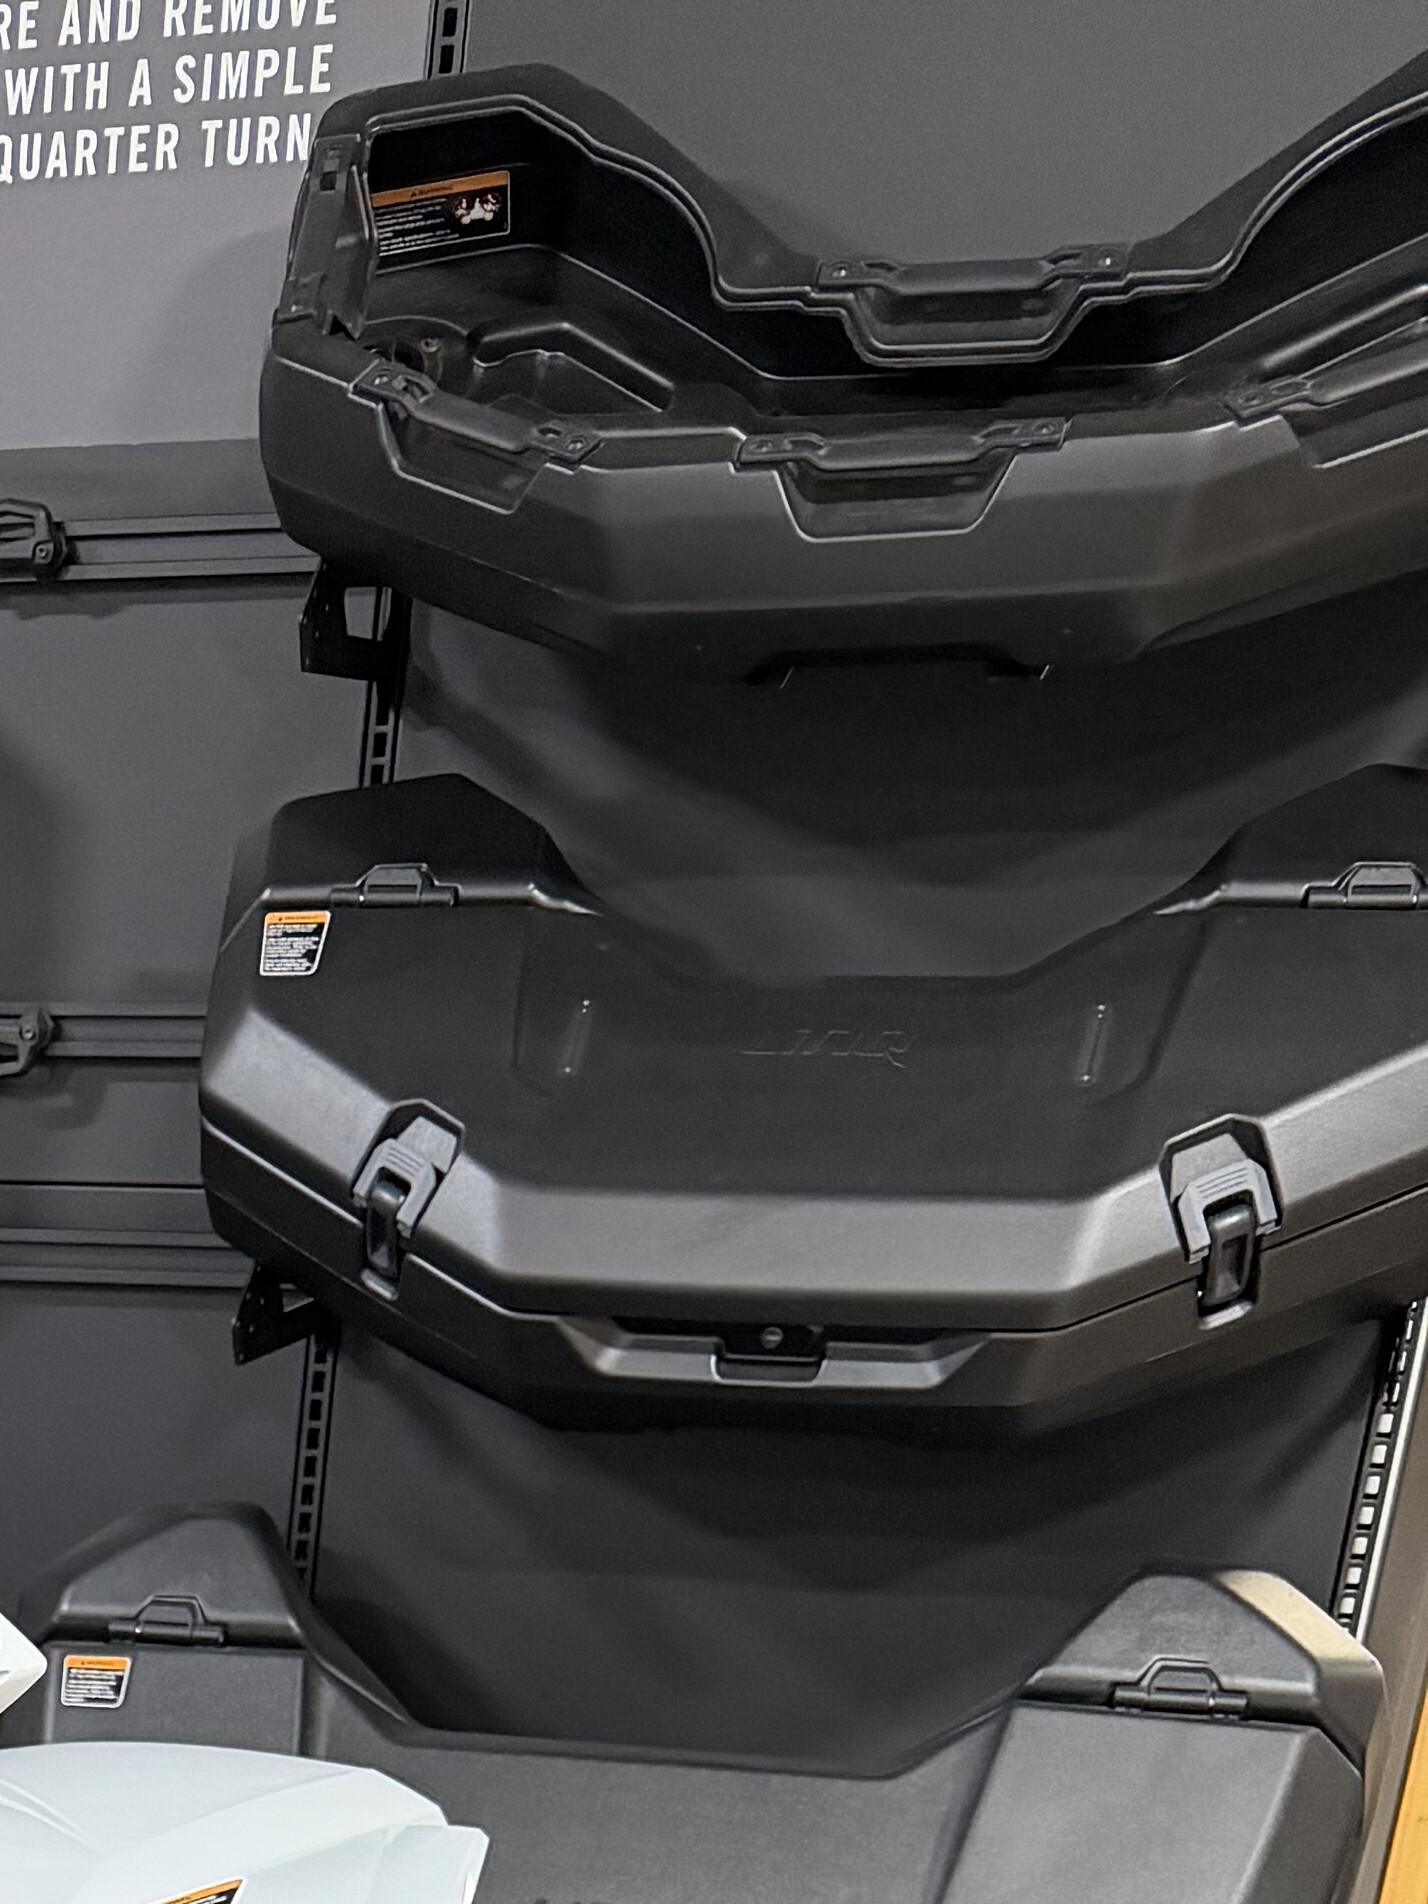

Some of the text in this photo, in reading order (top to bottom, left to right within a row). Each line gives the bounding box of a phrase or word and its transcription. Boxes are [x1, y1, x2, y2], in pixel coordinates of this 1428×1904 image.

[58, 0, 140, 46] AND
[162, 0, 338, 38] REMOVE
[4, 44, 334, 116] WITH A SIMPLE
